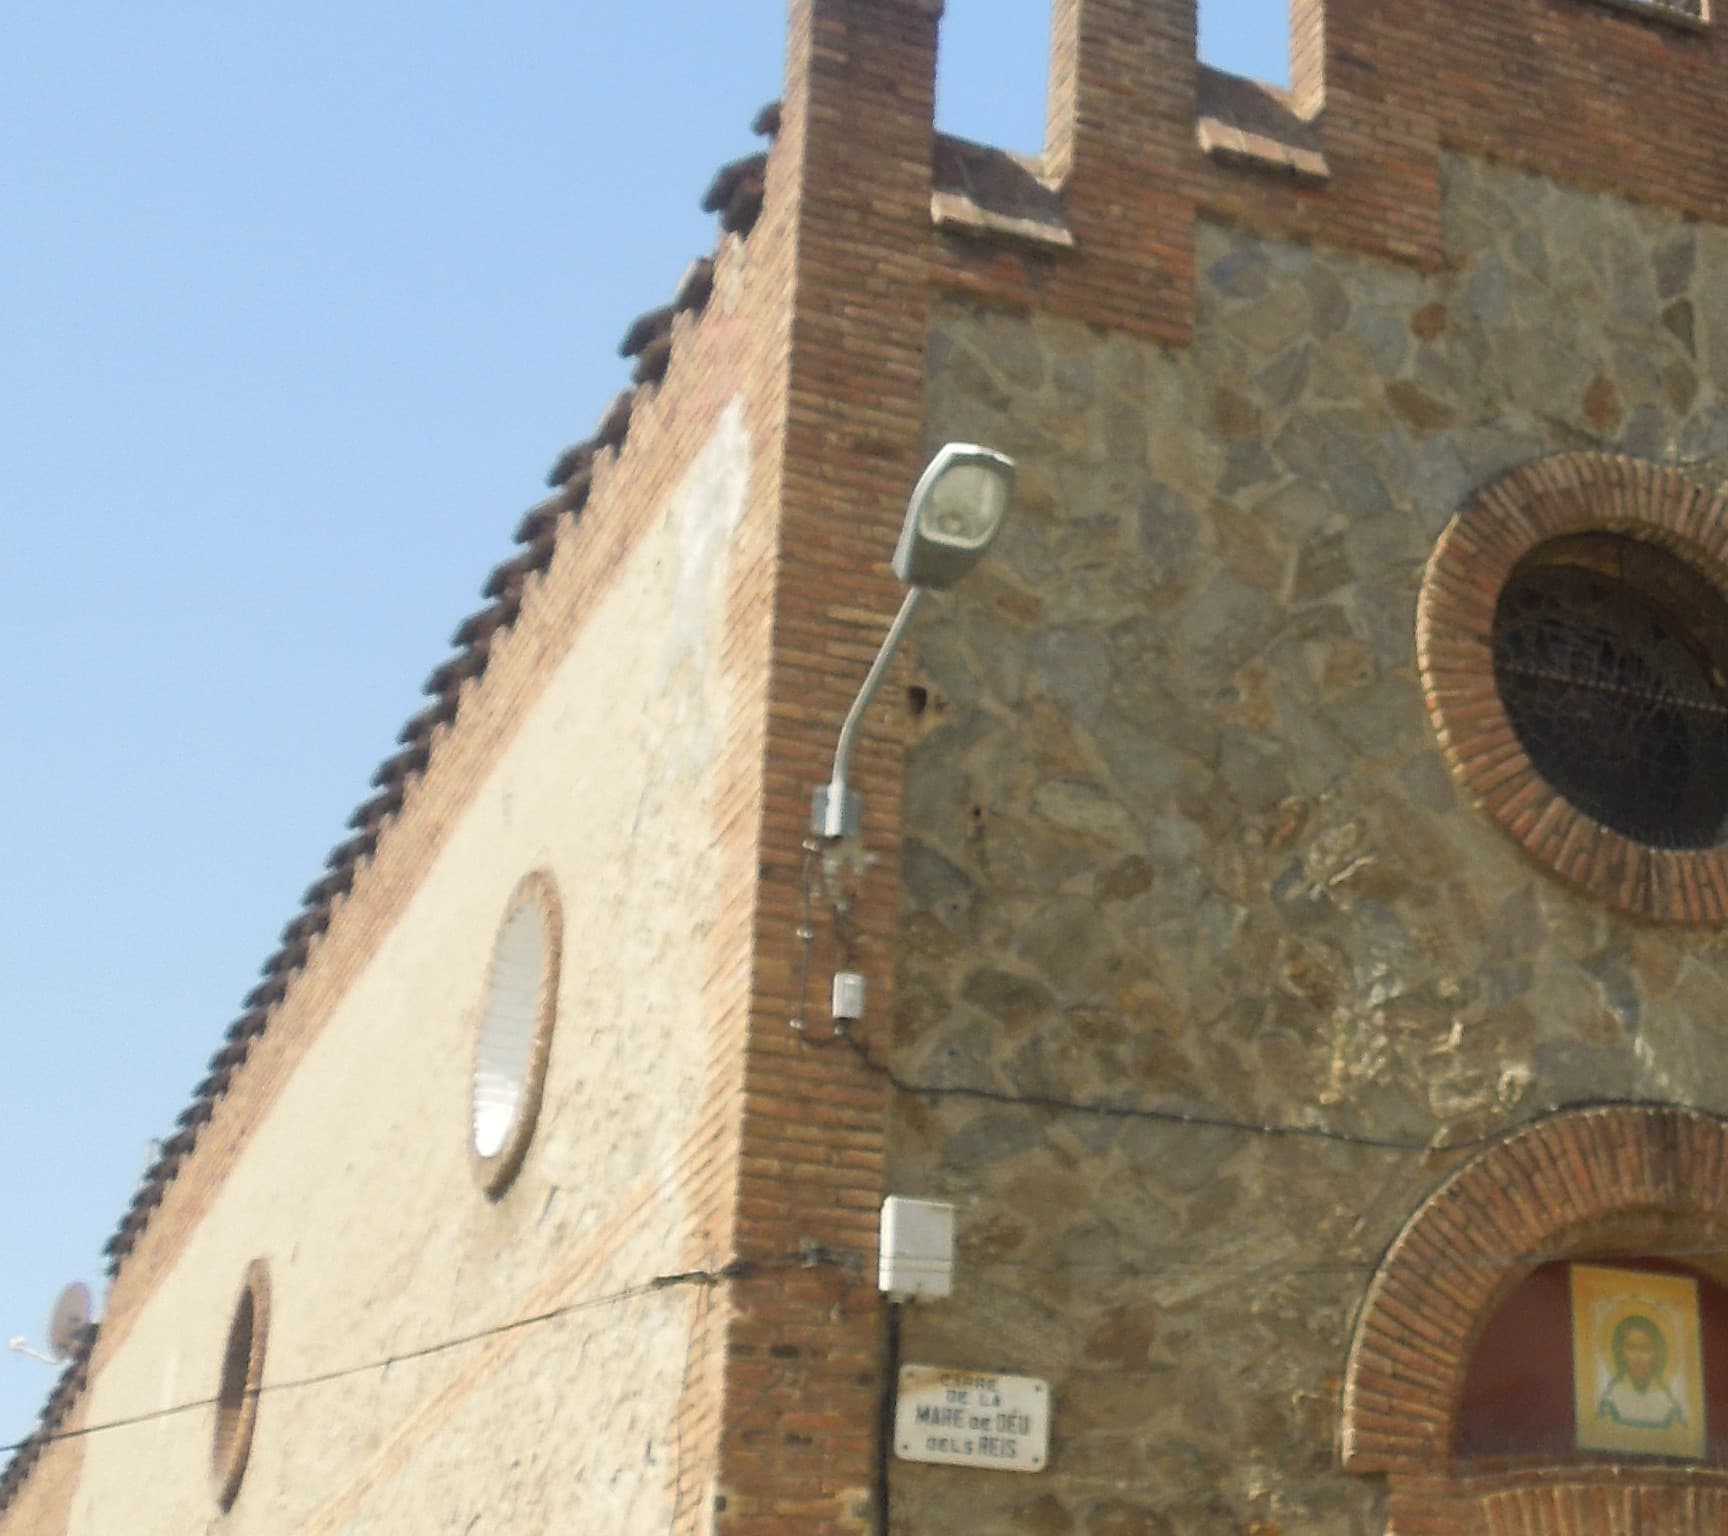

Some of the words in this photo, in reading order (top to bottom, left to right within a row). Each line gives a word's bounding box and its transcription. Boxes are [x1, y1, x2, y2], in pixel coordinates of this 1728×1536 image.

[946, 1390, 968, 1404] DE
[979, 1392, 1001, 1407] LA
[915, 1405, 966, 1429] MARE
[969, 1416, 991, 1431] DE
[926, 1436, 974, 1456] DELS
[978, 1436, 1017, 1459] REIS
